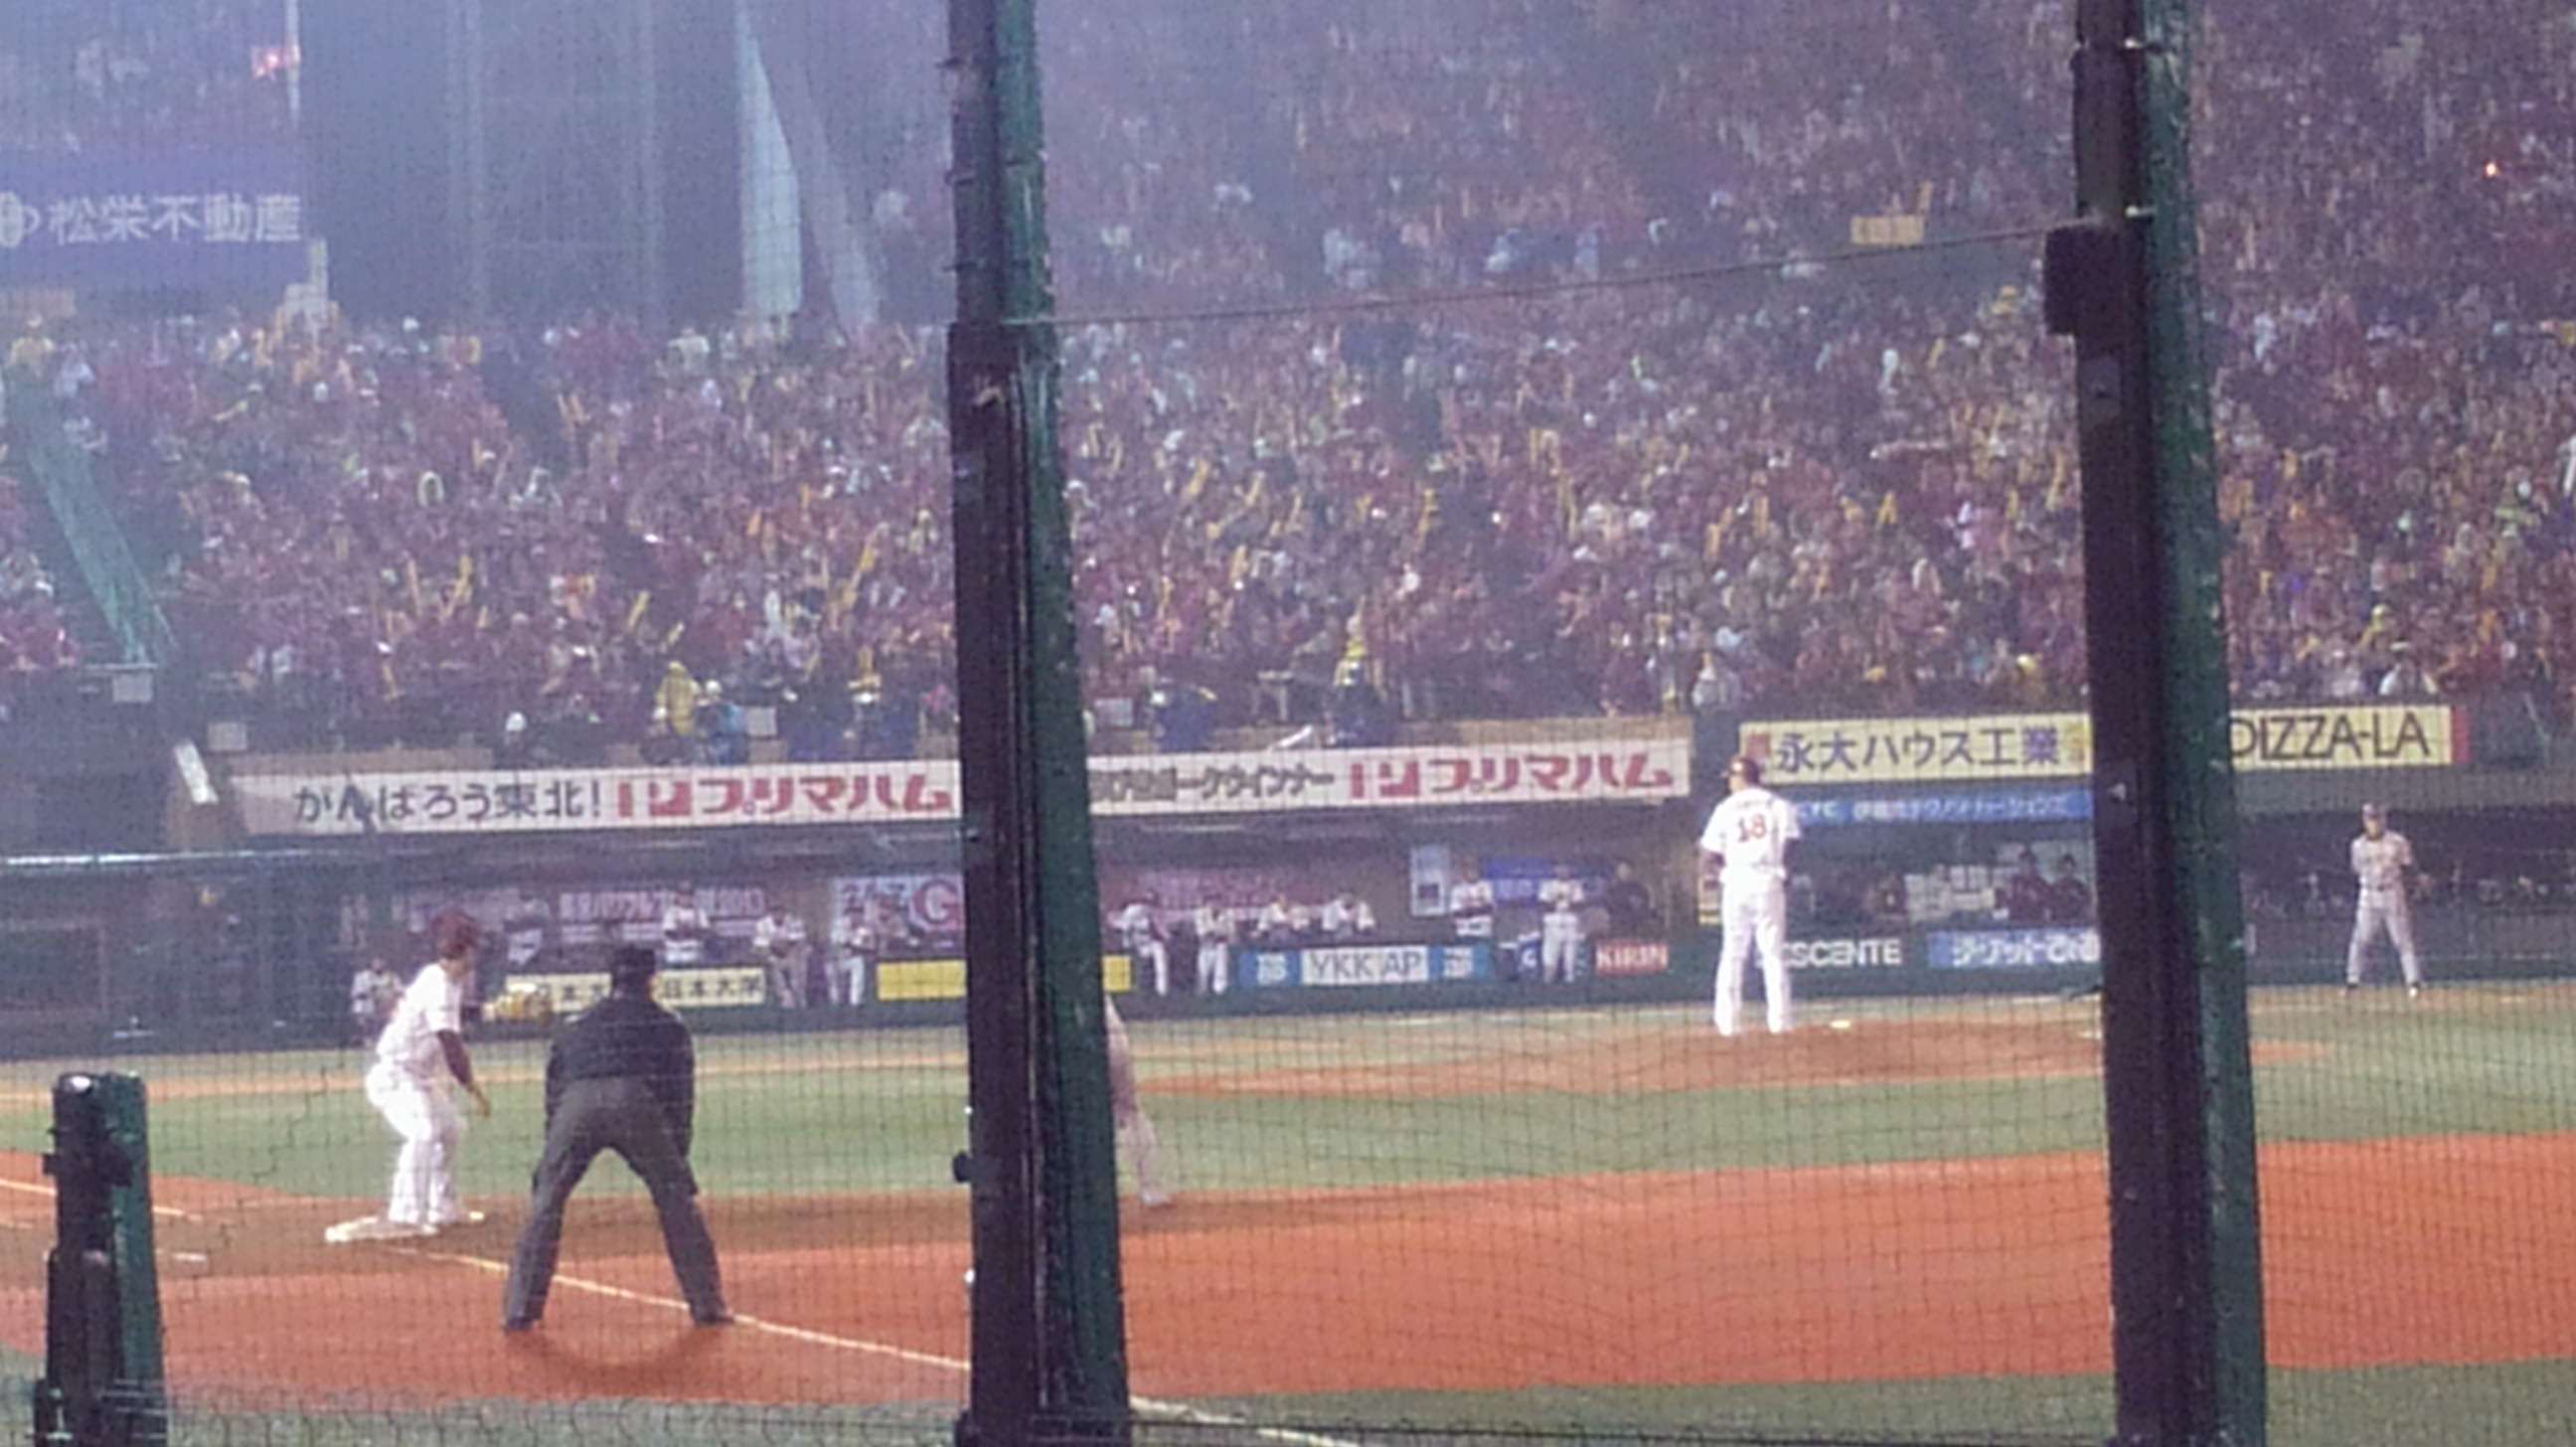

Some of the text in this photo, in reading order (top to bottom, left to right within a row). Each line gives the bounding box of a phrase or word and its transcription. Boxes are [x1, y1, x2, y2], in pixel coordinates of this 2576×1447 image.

[49, 193, 301, 246] 松栄不動産
[1776, 726, 2059, 774] 永大ハウス工業
[1737, 813, 1767, 843] 18
[1596, 945, 1668, 970] KIRIN
